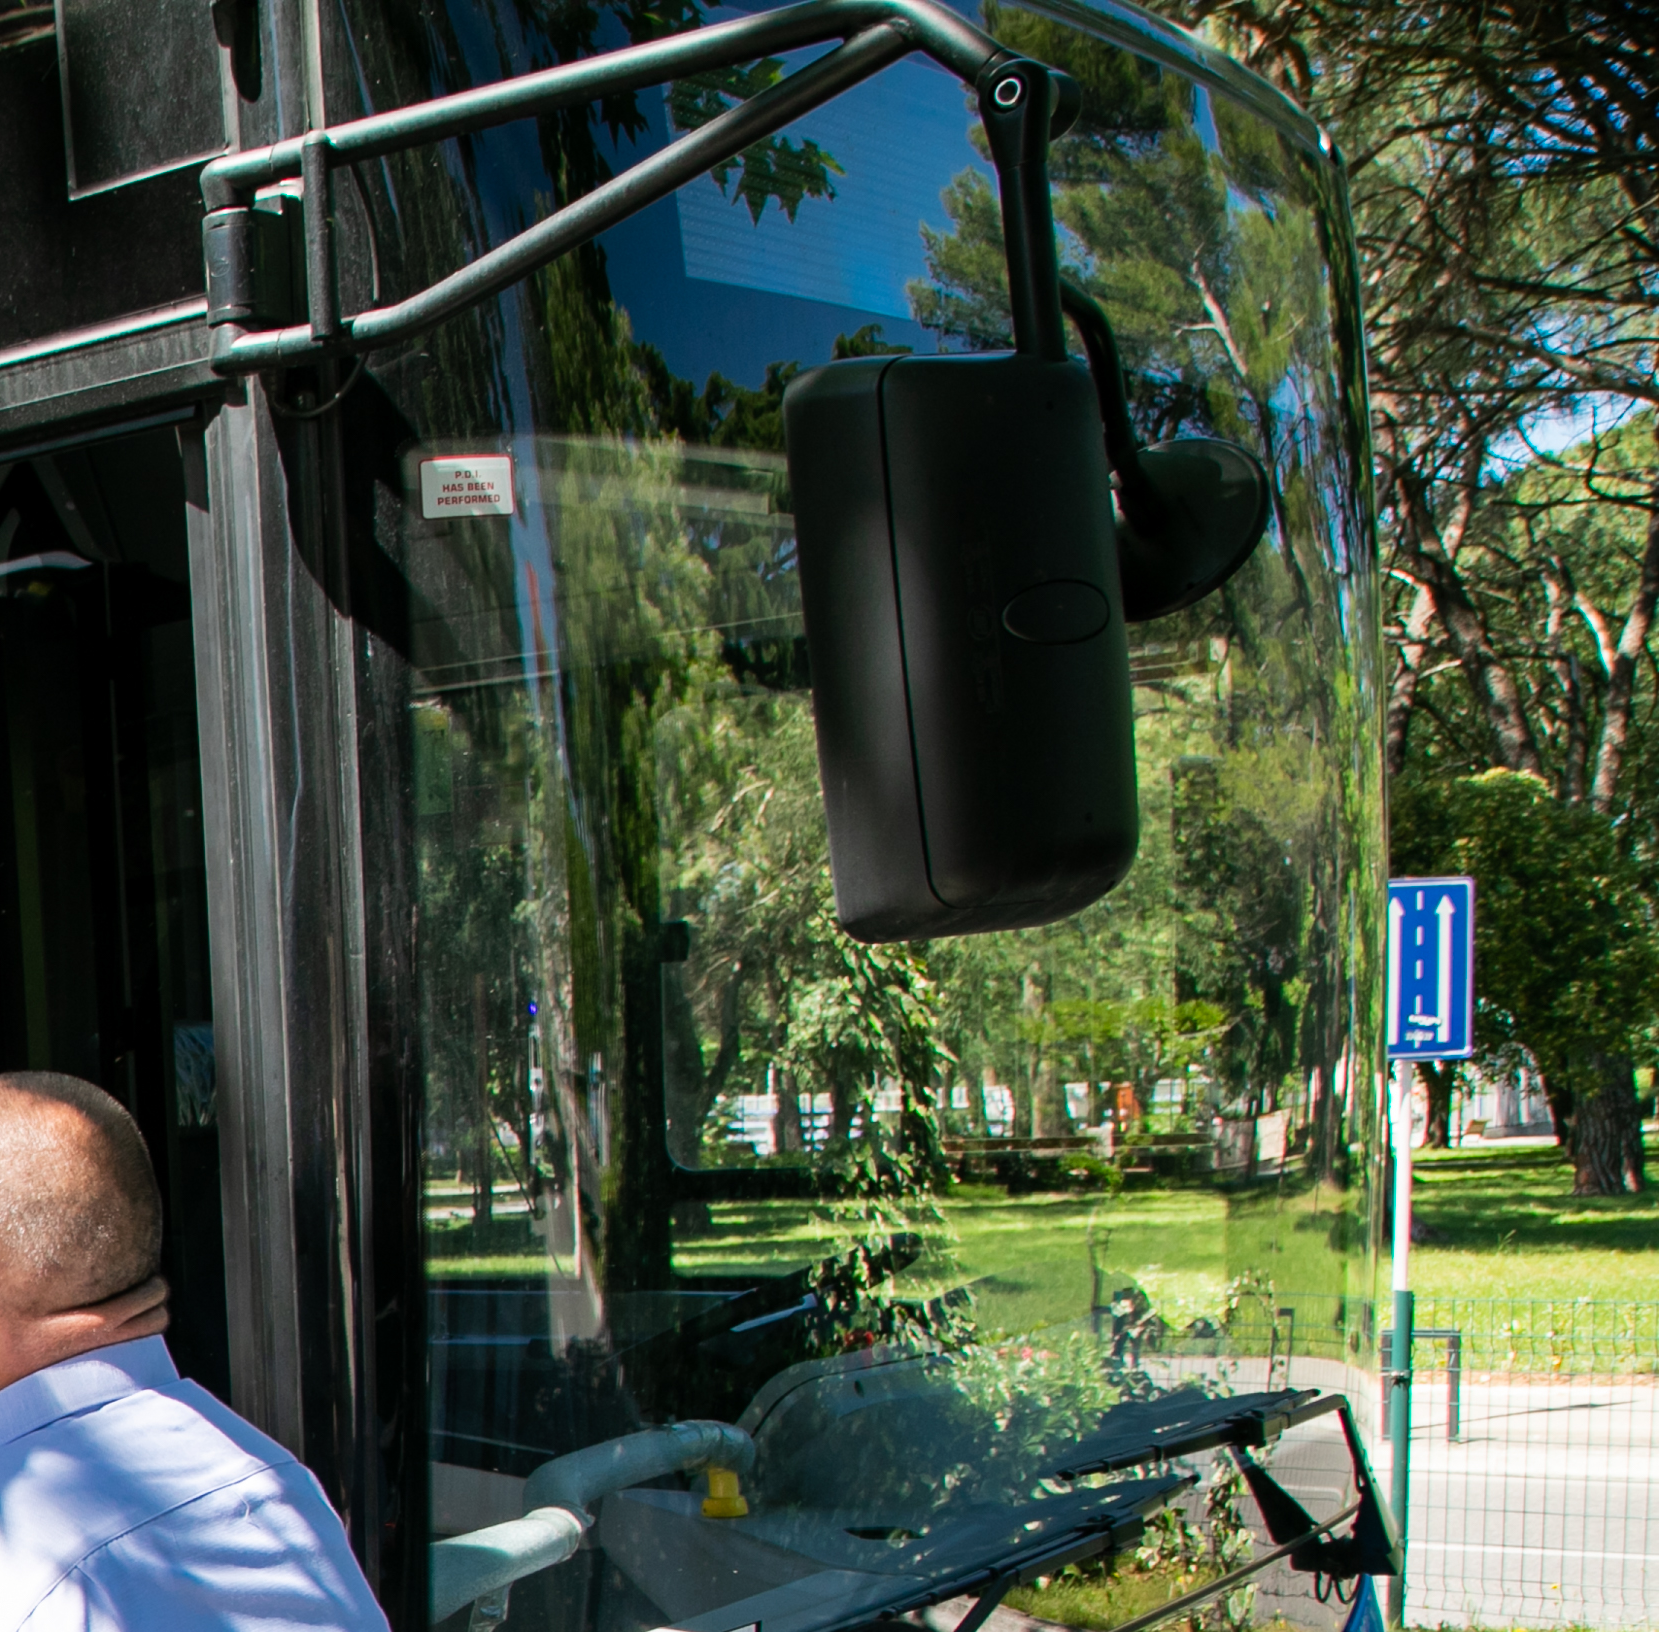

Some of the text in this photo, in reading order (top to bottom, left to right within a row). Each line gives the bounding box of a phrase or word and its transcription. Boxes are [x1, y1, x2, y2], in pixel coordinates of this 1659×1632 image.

[442, 482, 495, 493] HAS BEEN
[437, 495, 500, 506] PERFORMED
